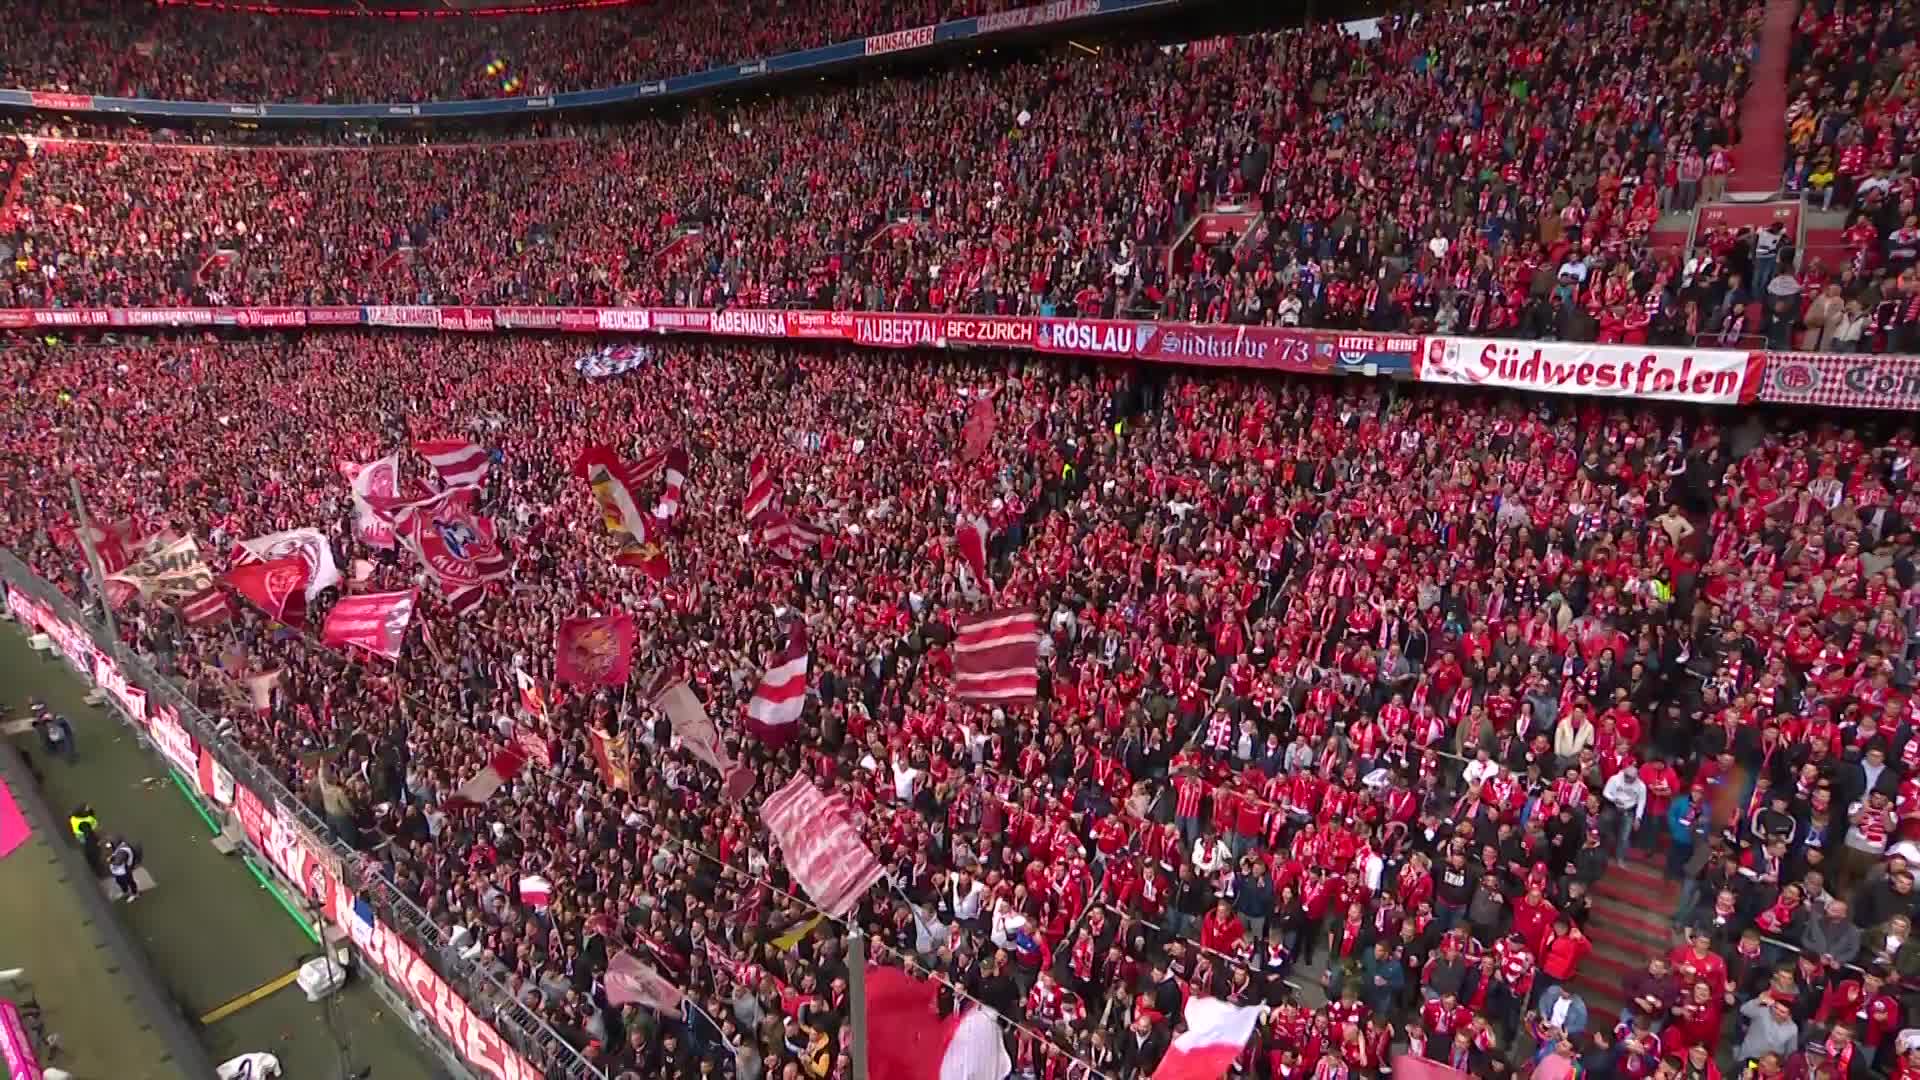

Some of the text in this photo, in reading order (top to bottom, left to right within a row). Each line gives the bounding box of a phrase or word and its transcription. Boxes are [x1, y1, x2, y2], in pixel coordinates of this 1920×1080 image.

[947, 320, 1032, 341] BFC ZÜRICH
[1053, 321, 1131, 351] RÖSLAU
[1339, 336, 1374, 350] LETZTE
[1465, 343, 1738, 396] Südwestfalen
